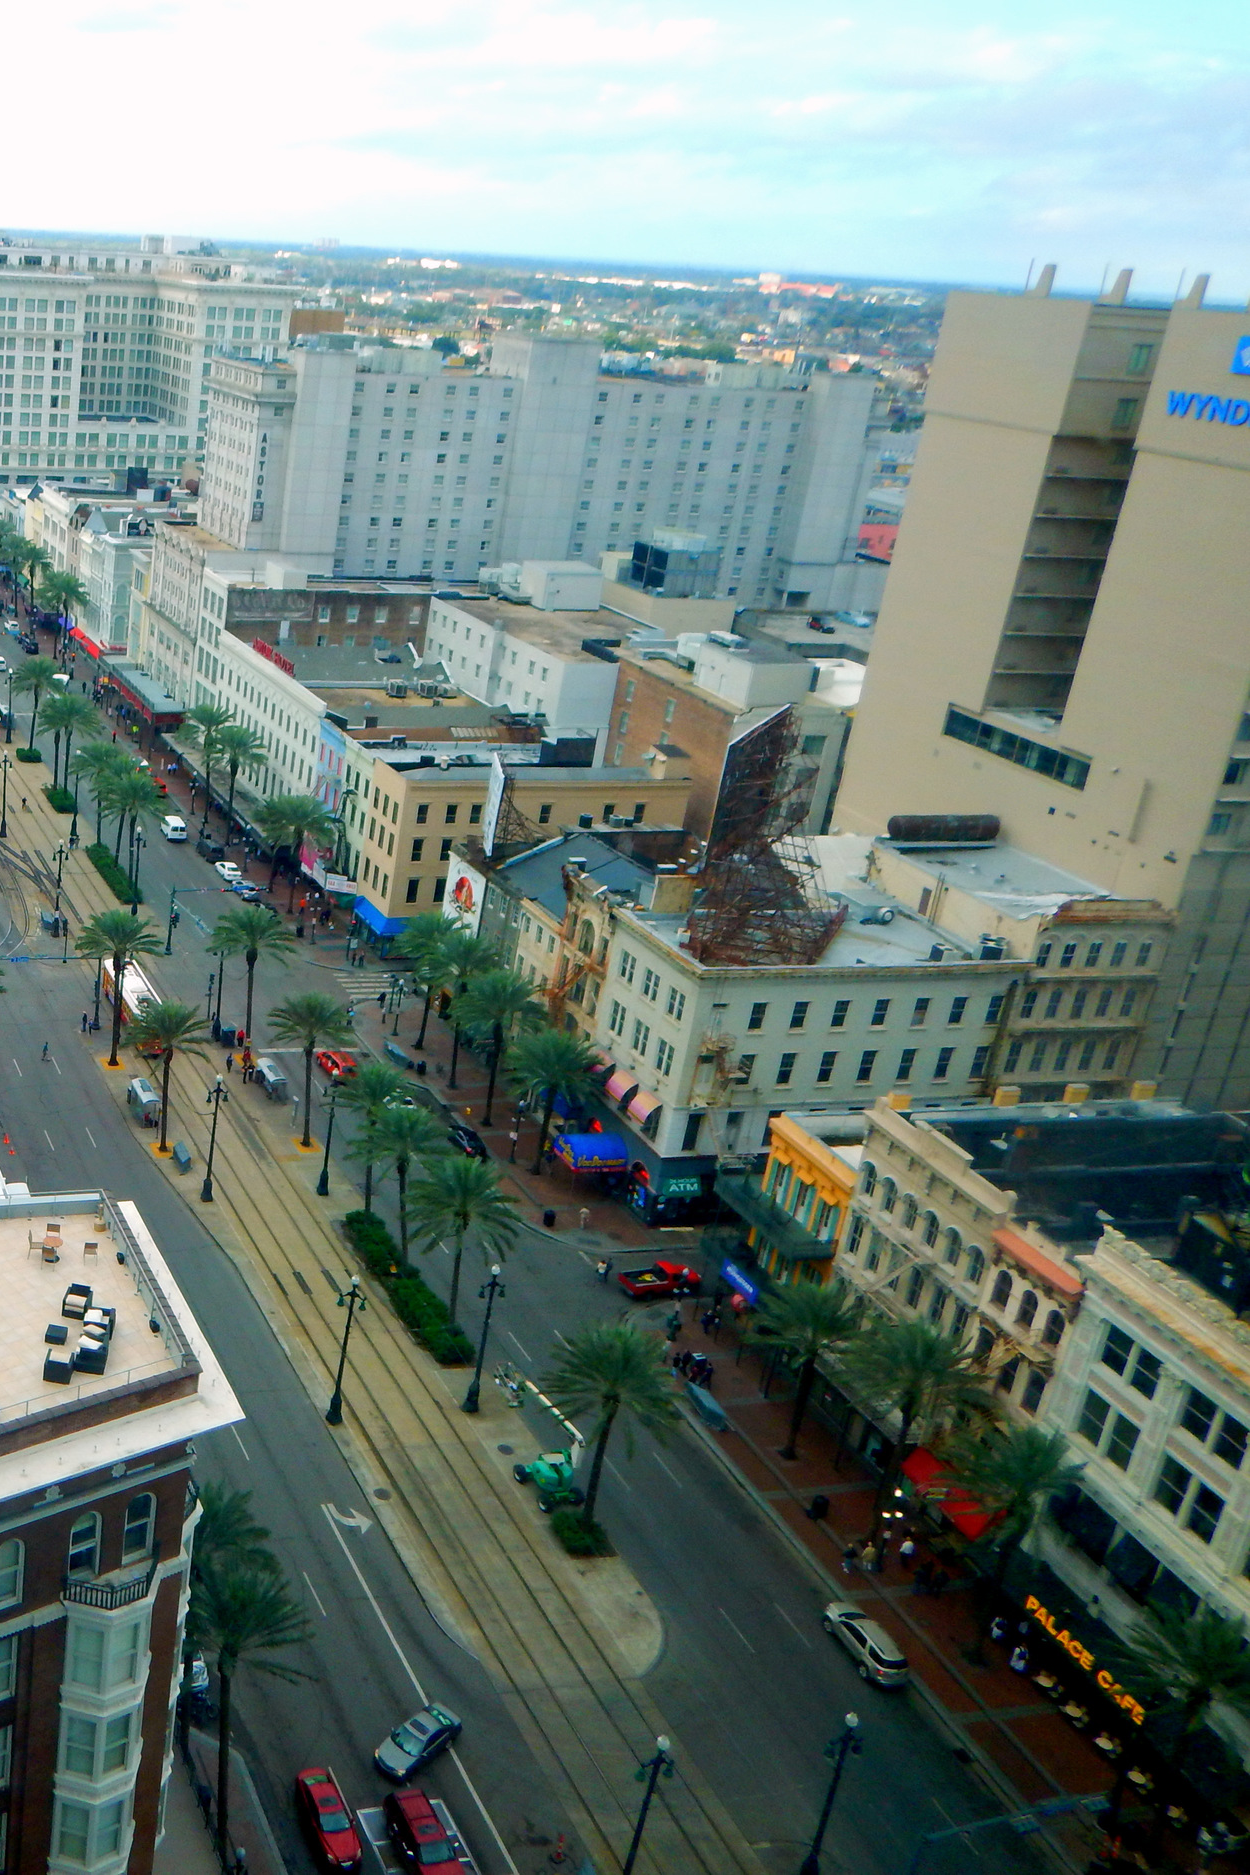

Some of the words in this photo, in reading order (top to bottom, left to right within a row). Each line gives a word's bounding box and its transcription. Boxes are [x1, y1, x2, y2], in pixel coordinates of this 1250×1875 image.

[1167, 390, 1250, 427] WYND
[256, 432, 268, 499] ASTOR
[669, 1183, 698, 1192] ATM
[1025, 1595, 1095, 1671] PALACE
